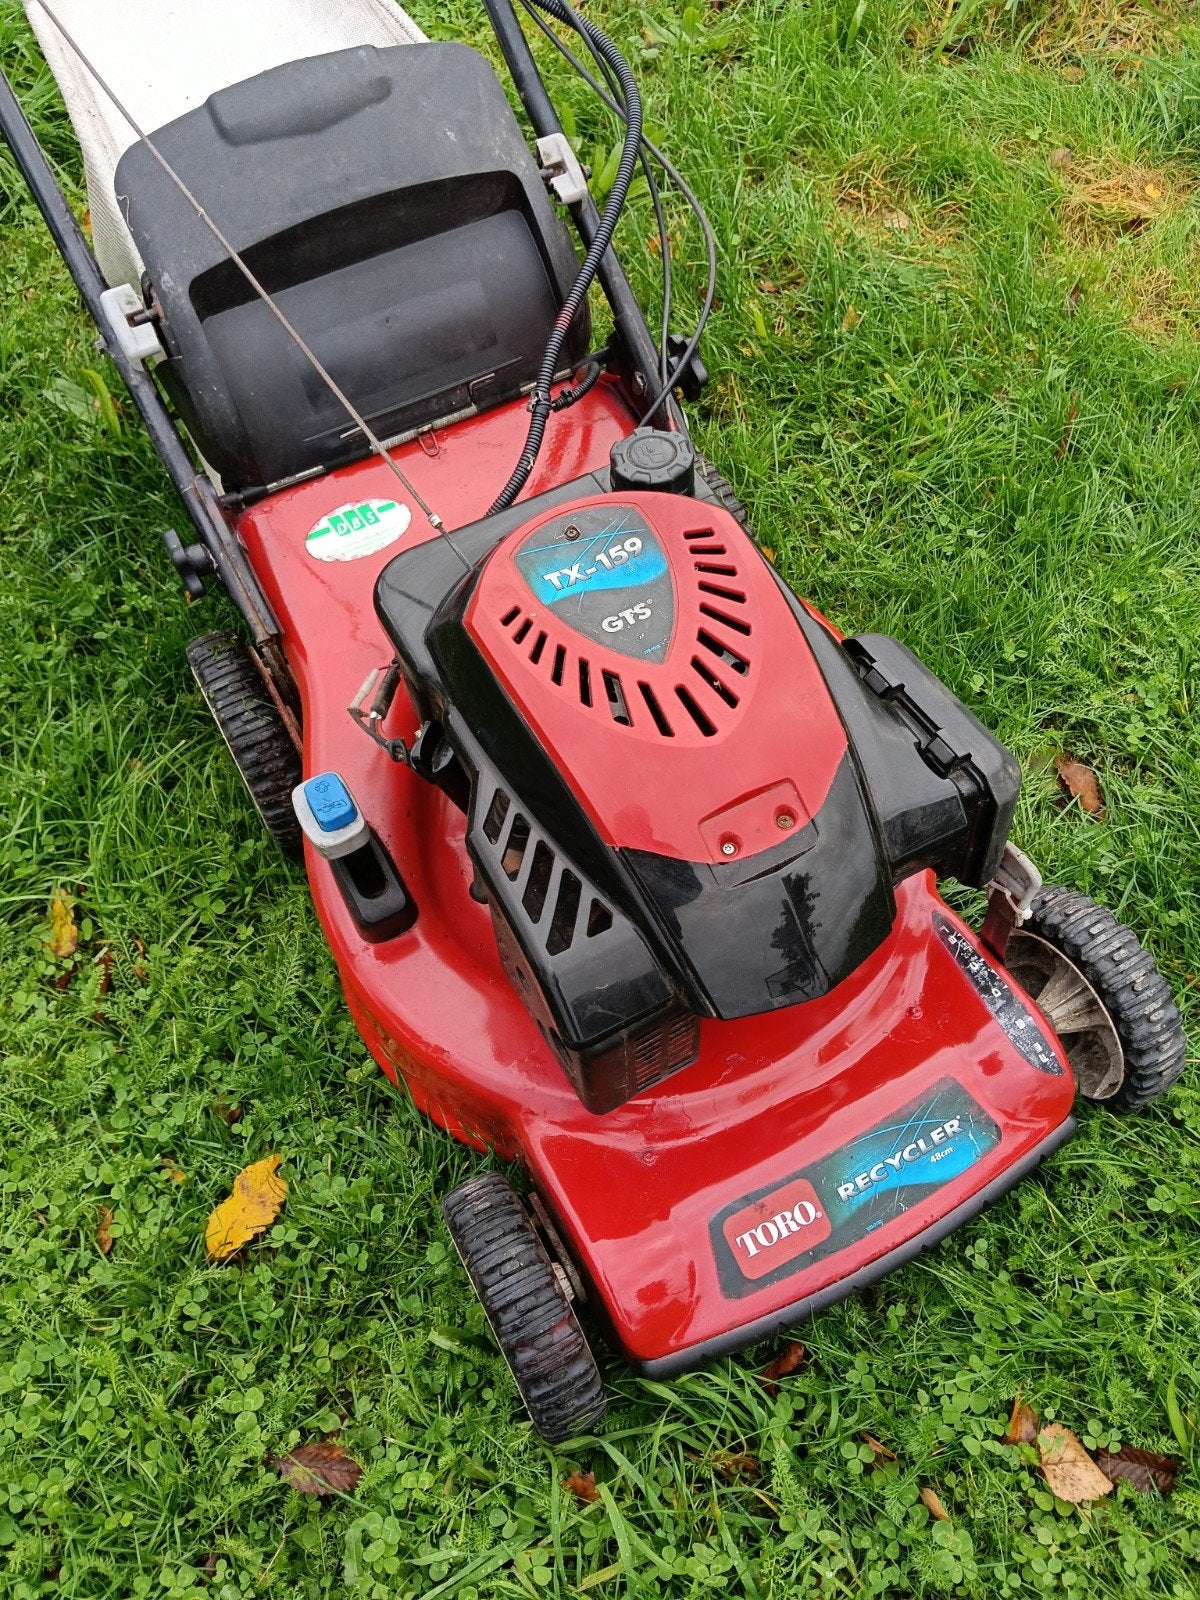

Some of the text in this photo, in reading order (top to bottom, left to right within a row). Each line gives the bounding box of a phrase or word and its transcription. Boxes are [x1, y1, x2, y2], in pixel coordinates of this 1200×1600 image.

[543, 537, 642, 591] TX-159
[601, 602, 652, 633] GTS
[930, 1146, 954, 1164] 48cm
[736, 1118, 964, 1257] TORO RECYCLER
